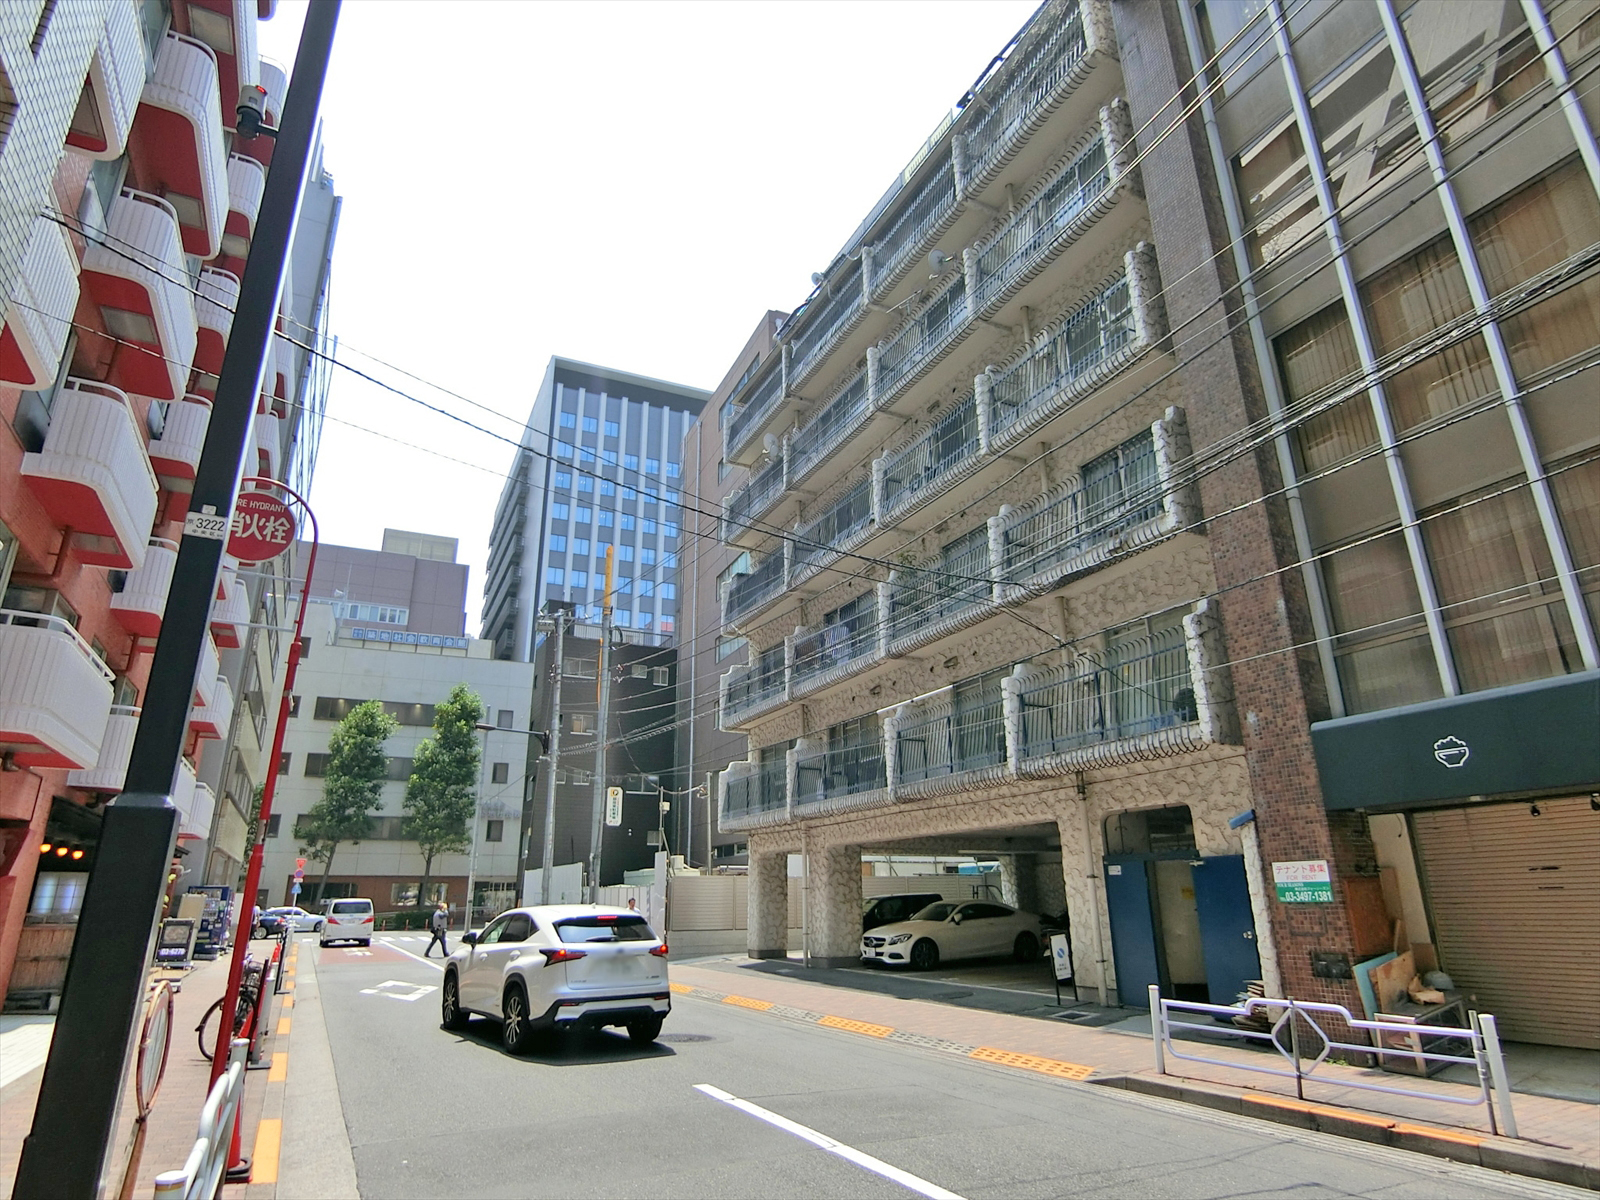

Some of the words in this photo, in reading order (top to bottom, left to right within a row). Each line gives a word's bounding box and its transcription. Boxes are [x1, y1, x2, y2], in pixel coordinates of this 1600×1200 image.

[237, 498, 248, 507] RE
[249, 500, 287, 513] HYDRANT
[196, 517, 225, 532] 3222
[1276, 864, 1326, 874] テナント募集
[1285, 891, 1332, 901] 03-3497-1381
